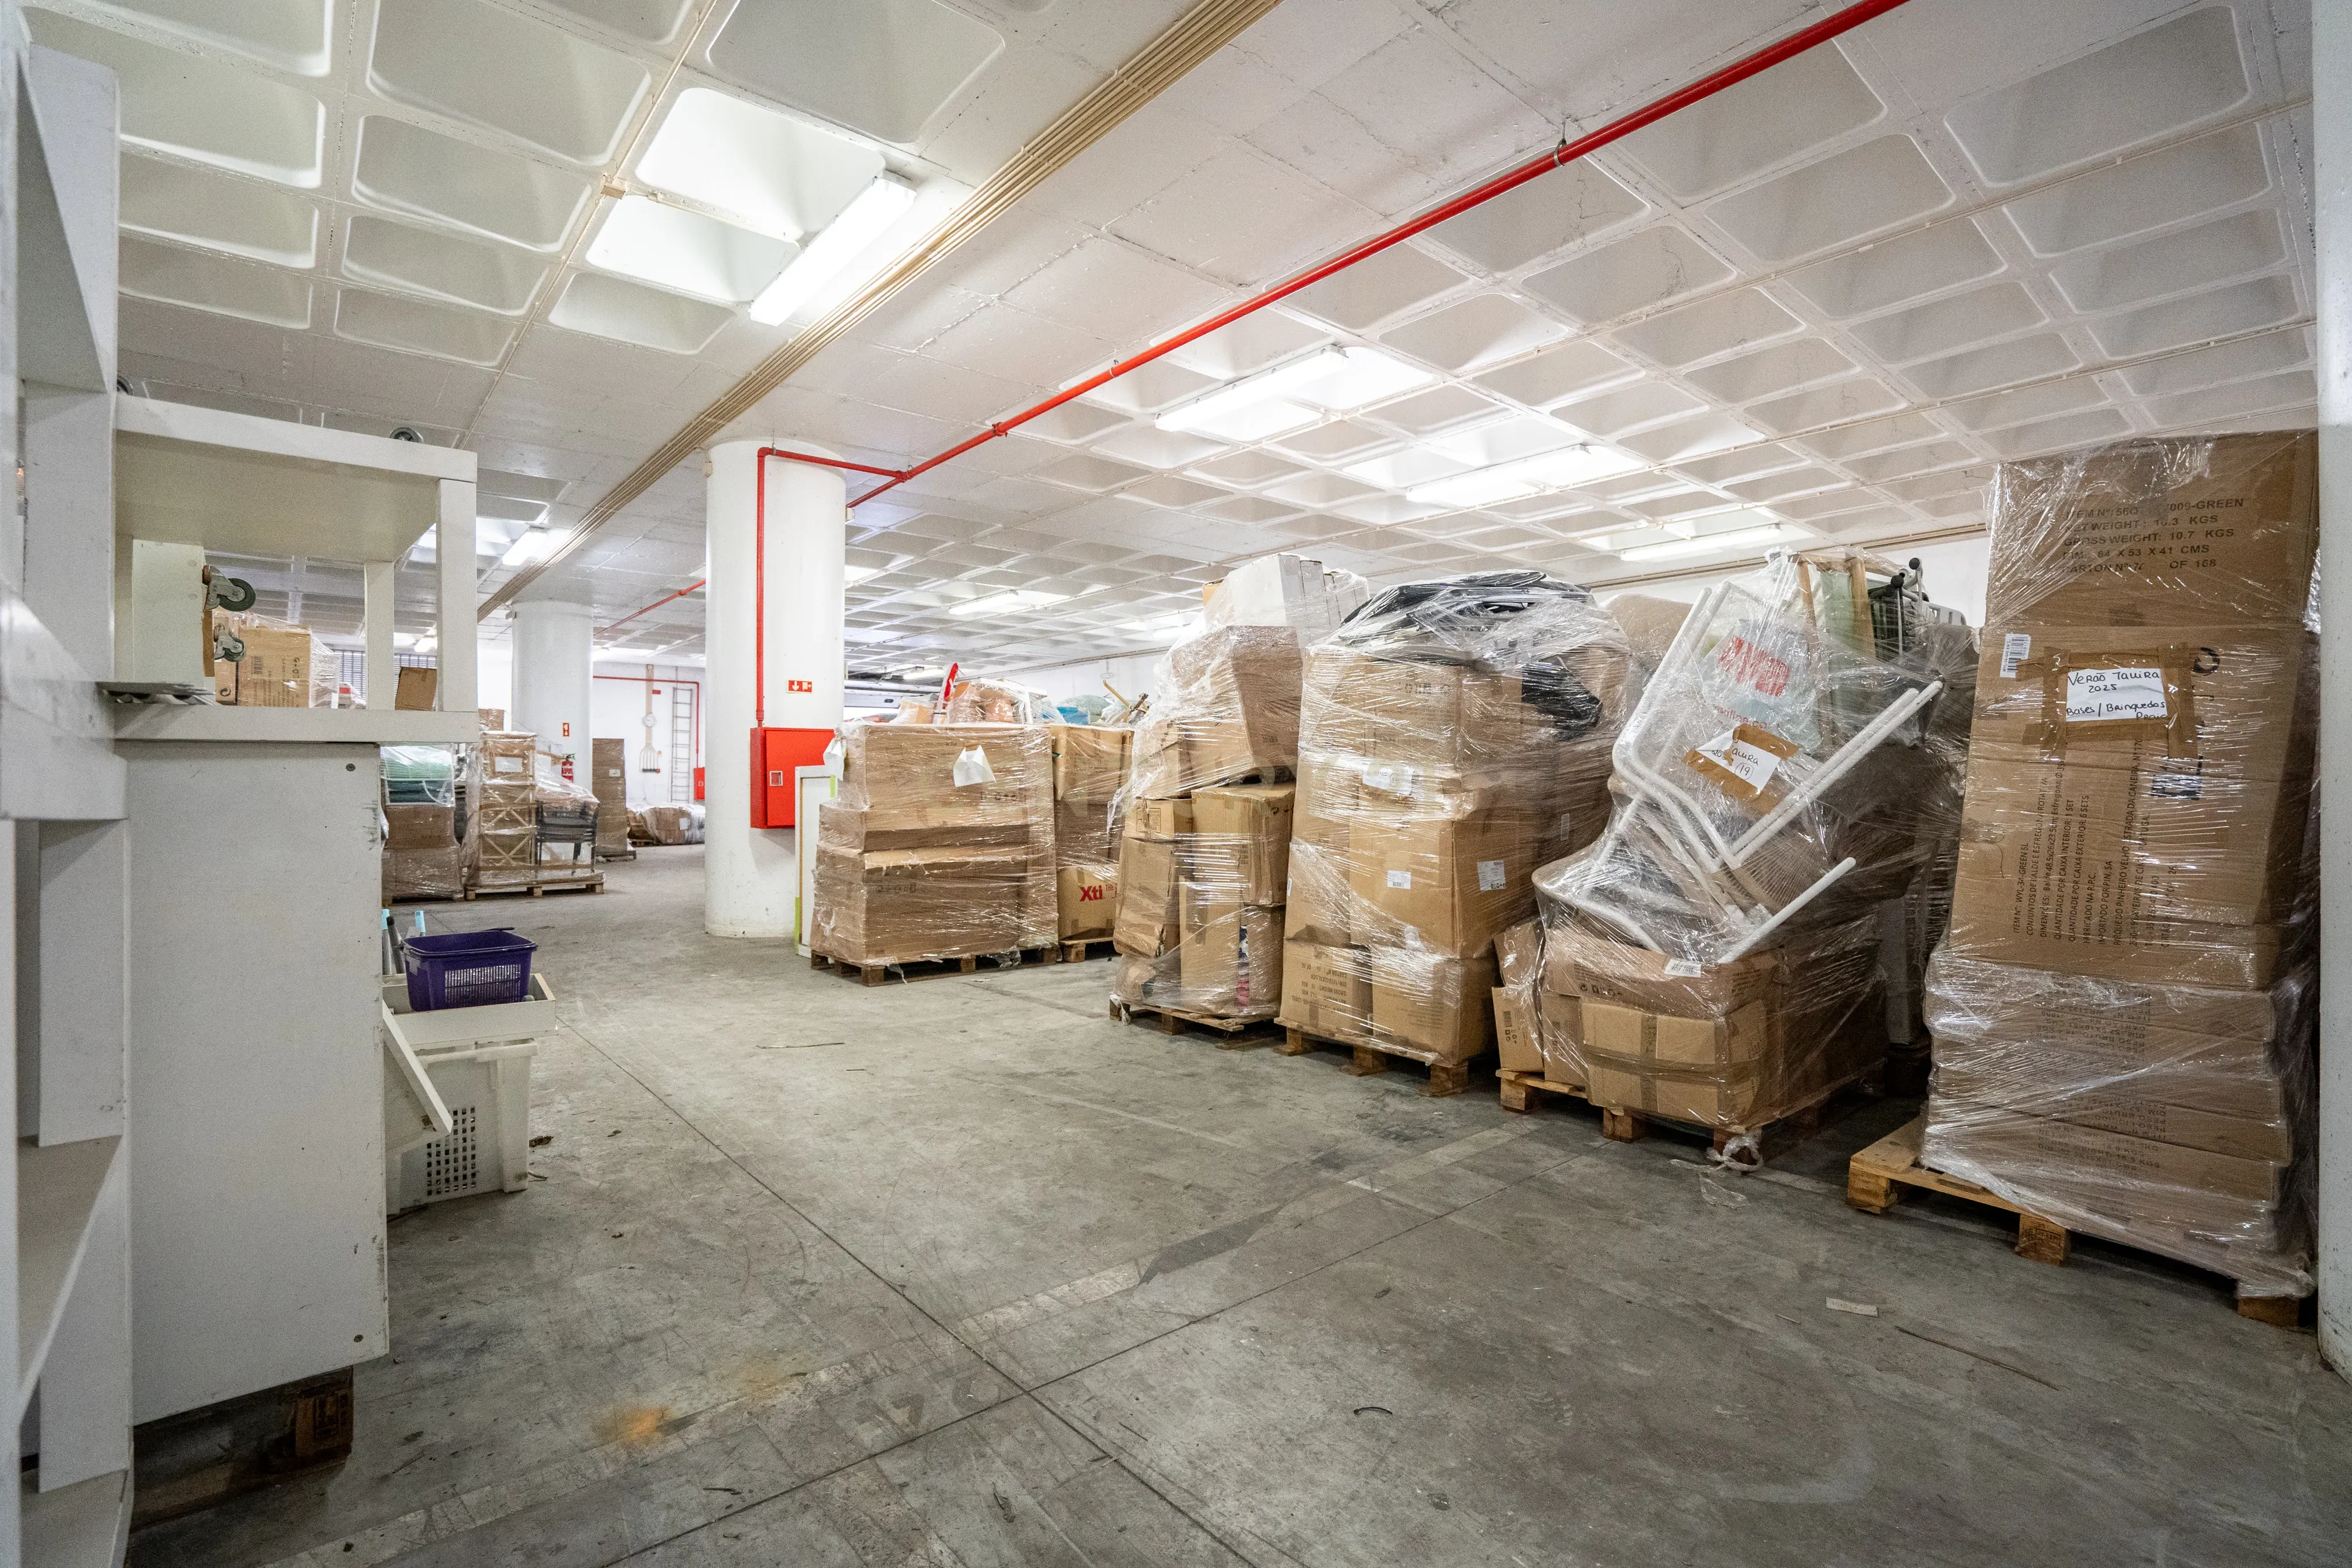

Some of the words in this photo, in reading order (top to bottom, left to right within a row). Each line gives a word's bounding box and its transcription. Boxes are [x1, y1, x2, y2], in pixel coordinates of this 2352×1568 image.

[2189, 515, 2218, 524] KGS
[2064, 537, 2106, 546] GROSS
[2109, 533, 2162, 544] WEIGHT:
[2170, 530, 2195, 540] 10.7
[2205, 528, 2234, 538] KGS
[2117, 549, 2124, 557] X
[2128, 548, 2142, 557] 53
[2148, 548, 2156, 556] X
[2159, 546, 2173, 555] 41
[2181, 545, 2210, 554] CMS
[2169, 560, 2188, 569] OF
[2088, 684, 2117, 693] 2025
[1739, 765, 1750, 776] 19
[2065, 799, 2074, 812] SET
[2080, 795, 2090, 812] SETS
[2127, 799, 2136, 809] DA
[2123, 811, 2134, 842] STRADA
[2061, 818, 2072, 854] INTERIOR:
[2076, 819, 2087, 855] EXTERIOR:
[2021, 843, 2029, 851] 5L
[2059, 855, 2068, 877] CAIXA
[2073, 857, 2083, 879] CAIXA
[2104, 861, 2113, 871] SA
[2015, 852, 2028, 902] WYL-34-GREEN
[2087, 872, 2096, 891] R.P.C.
[2103, 871, 2112, 886] PIN,
[2134, 876, 2143, 884] DE
[1080, 884, 1103, 901] Xti
[2029, 883, 2037, 893] DE
[2058, 878, 2066, 893] POR
[2072, 880, 2080, 894] POR
[2116, 871, 2127, 907] PINHEIRO
[2086, 893, 2094, 903] NA
[2102, 888, 2110, 902] POR
[2026, 894, 2036, 936] CONJUNTOS
[2053, 894, 2065, 940] QUANTIDADE
[2068, 896, 2079, 942] QUANTIDADE
[2114, 908, 2123, 919] DO
[2013, 917, 2021, 933] ITEM
[2083, 904, 2093, 944] FABRICADO
[2098, 904, 2108, 945] IMPORTADO
